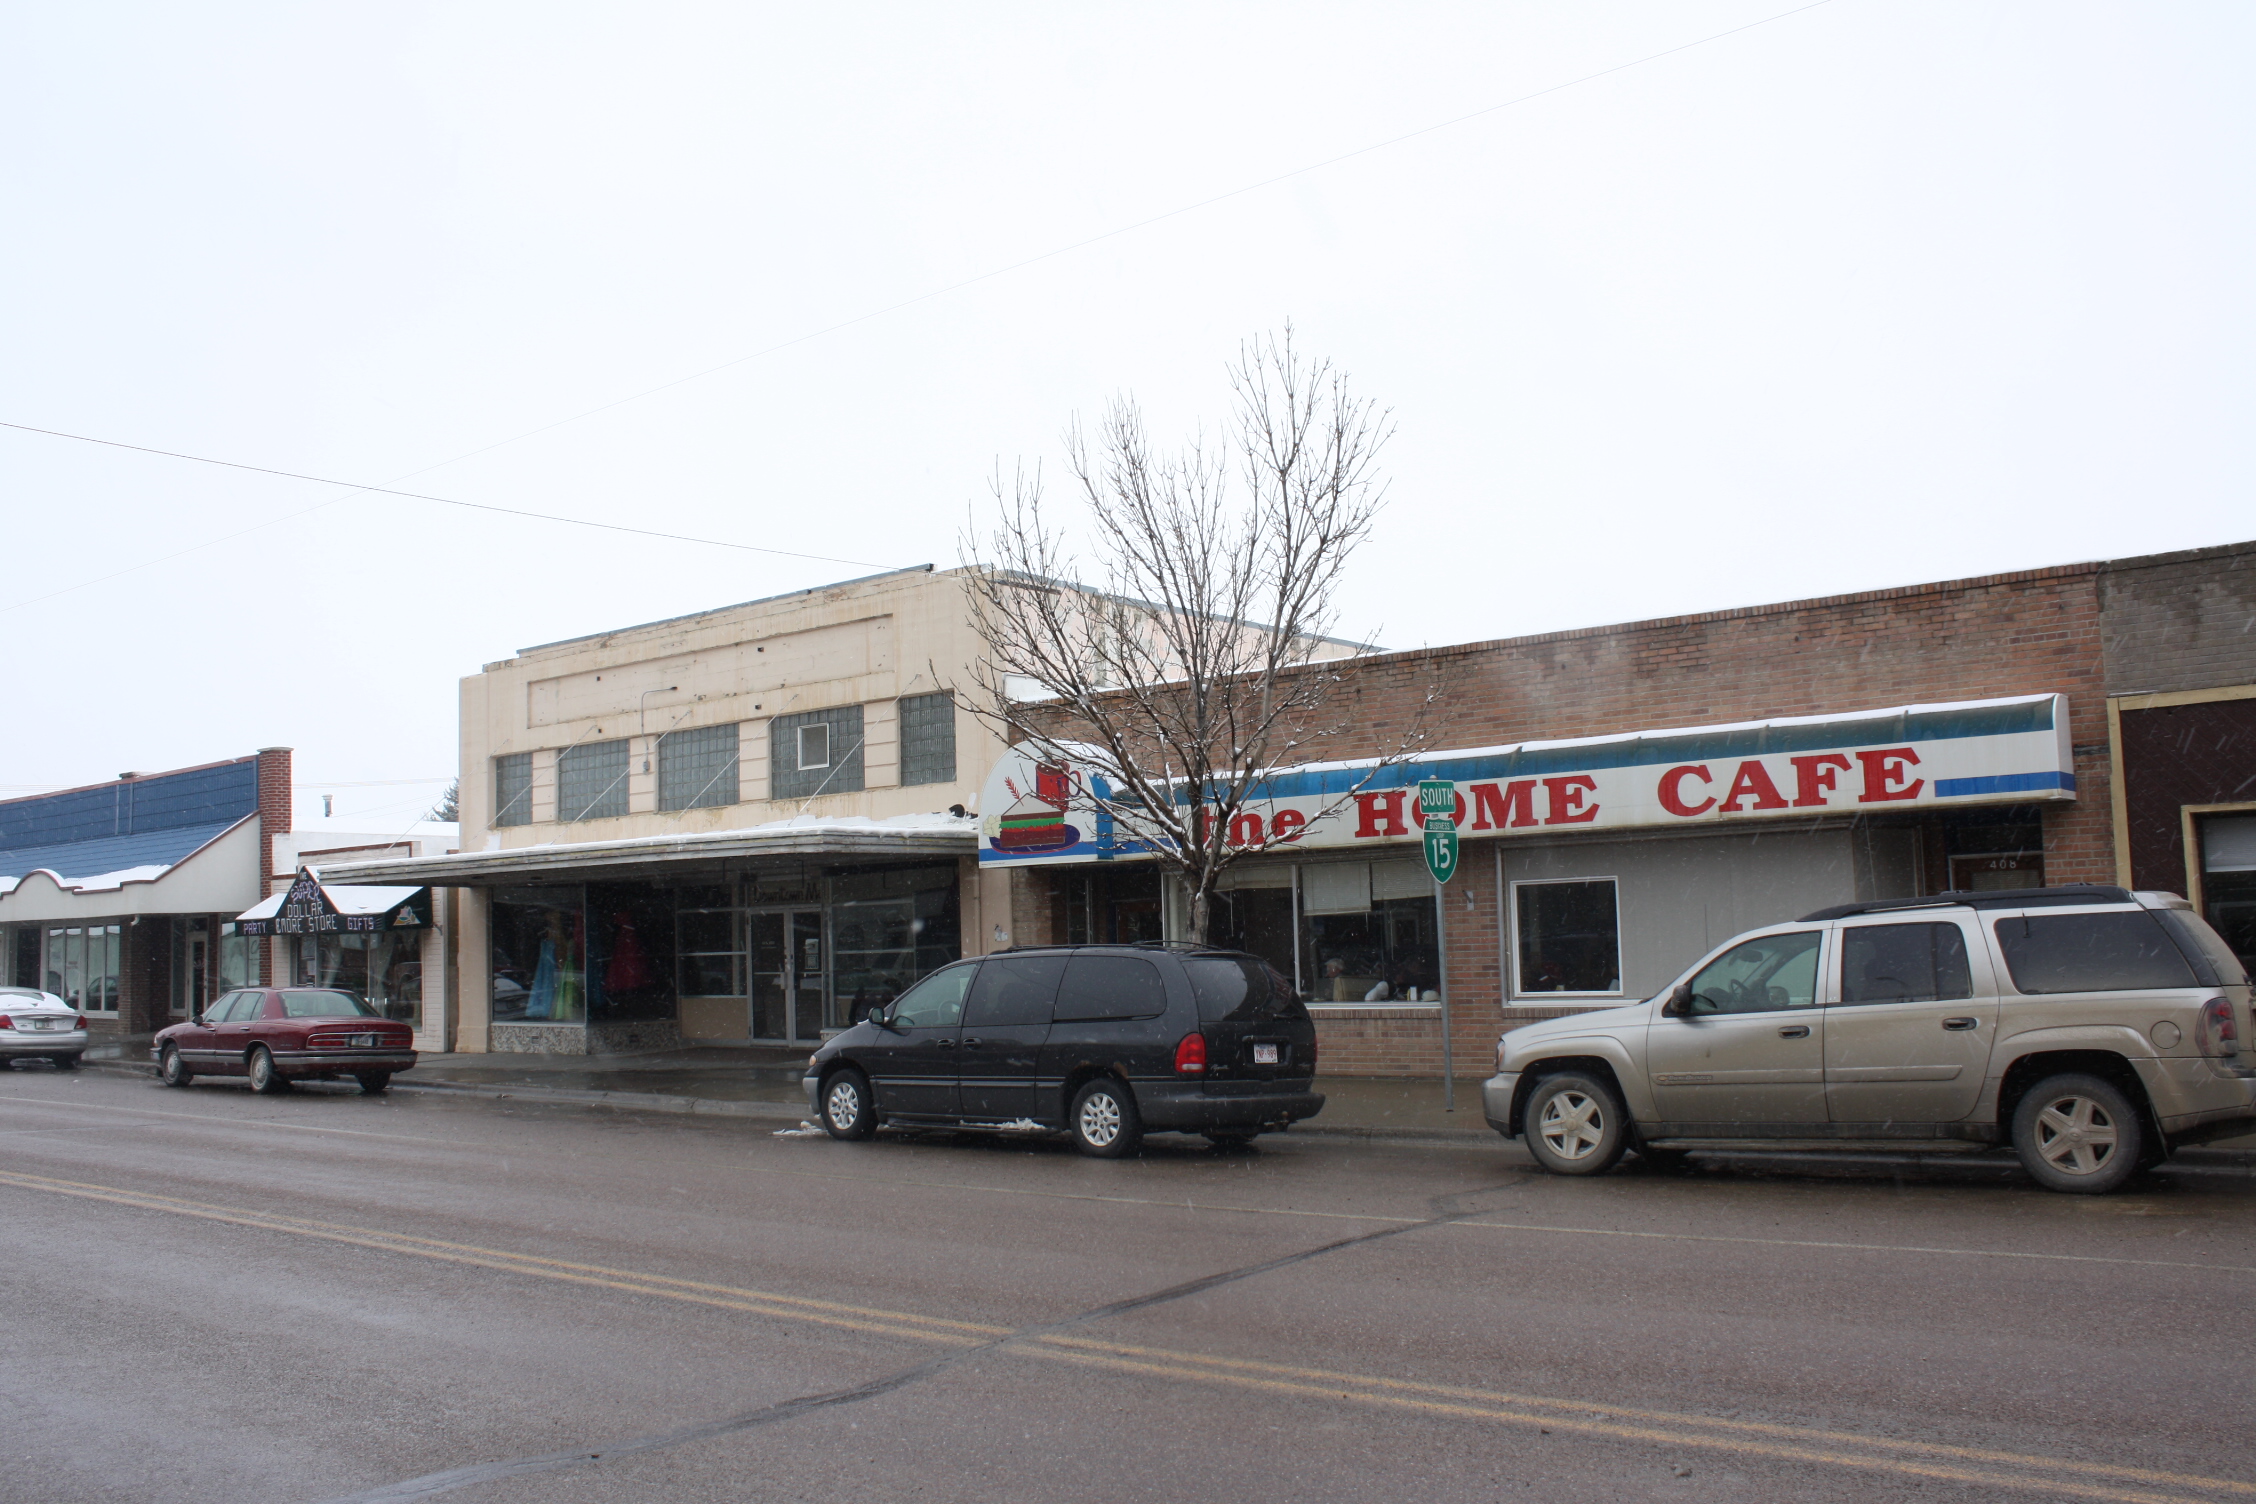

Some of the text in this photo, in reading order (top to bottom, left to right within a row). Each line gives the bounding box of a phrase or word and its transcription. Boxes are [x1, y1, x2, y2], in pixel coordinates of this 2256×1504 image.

[1657, 747, 1925, 817] CAFE
[1421, 787, 1454, 807] SOUTH
[1429, 821, 1451, 831] BUSINESS
[1432, 838, 1451, 869] 15
[1990, 860, 2017, 869] 408
[290, 881, 321, 904] SUPER
[287, 901, 324, 918] DOLLAR
[243, 920, 267, 935] PARTY
[308, 914, 338, 932] STORE
[347, 916, 375, 931] GIFTS
